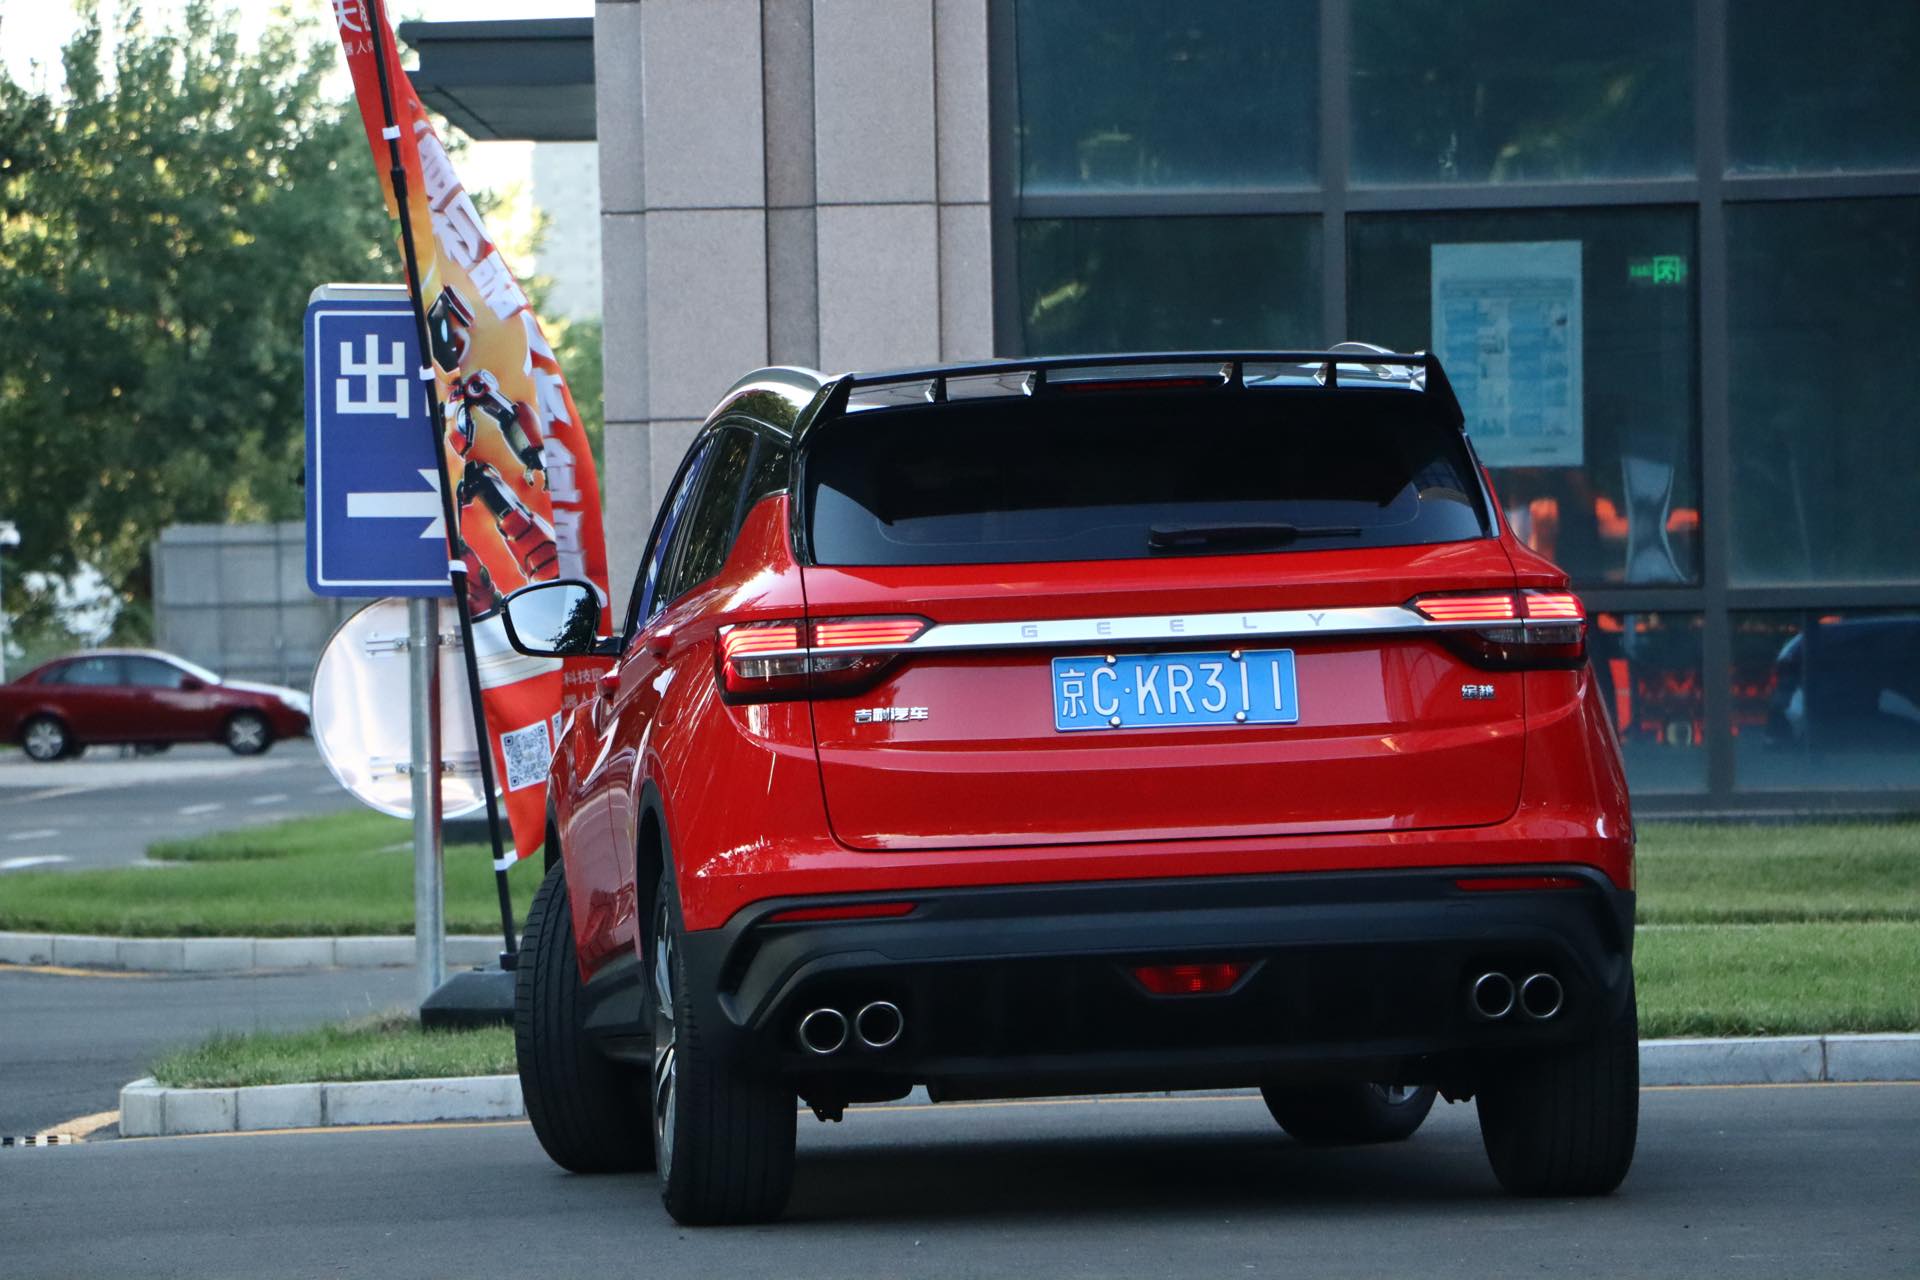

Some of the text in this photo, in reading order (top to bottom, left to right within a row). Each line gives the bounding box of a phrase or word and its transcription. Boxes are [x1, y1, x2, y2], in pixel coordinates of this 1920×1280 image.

[336, 334, 430, 419] 出
[1021, 613, 1325, 639] GEELY
[855, 707, 929, 723] 吉利汽车
